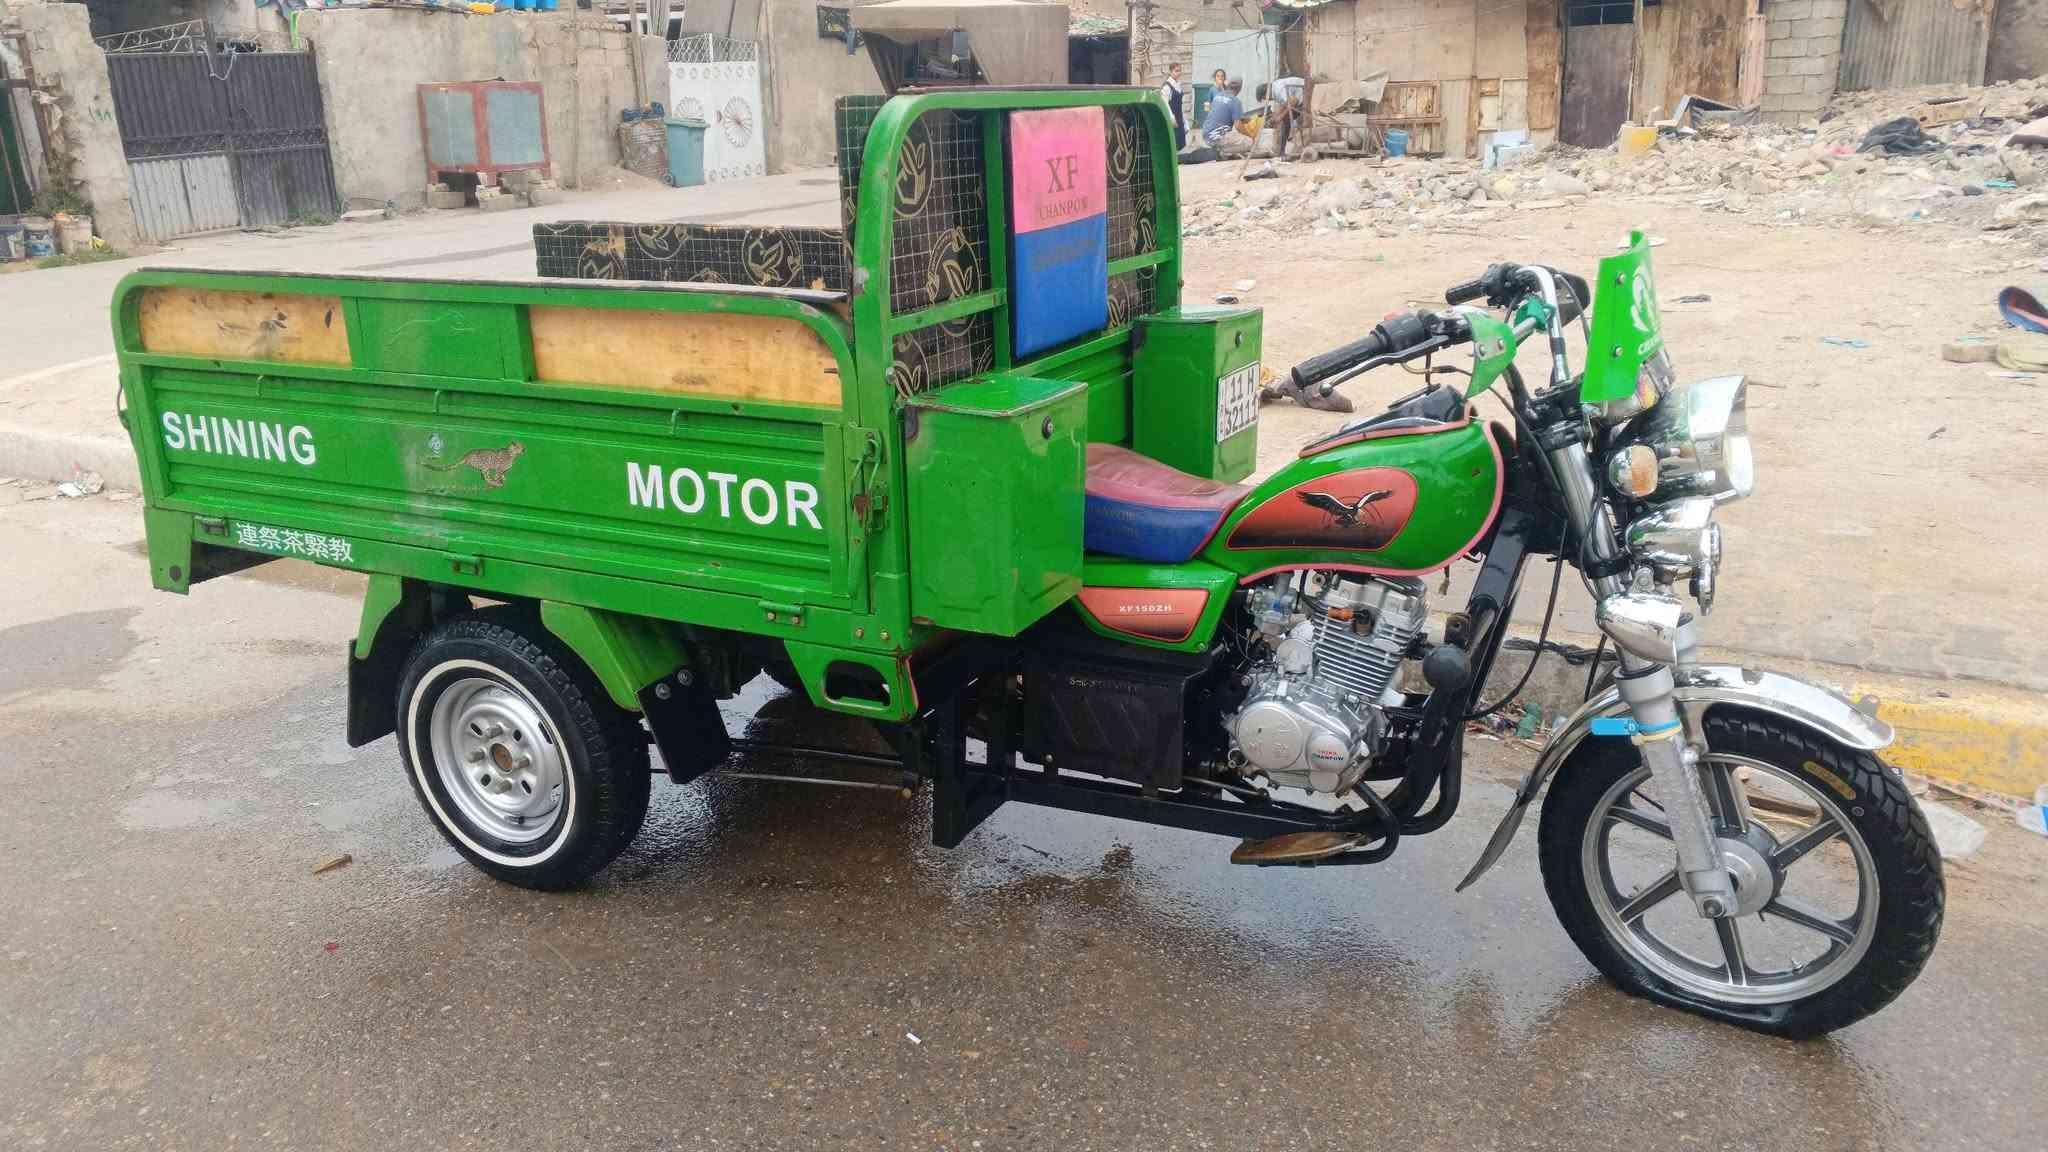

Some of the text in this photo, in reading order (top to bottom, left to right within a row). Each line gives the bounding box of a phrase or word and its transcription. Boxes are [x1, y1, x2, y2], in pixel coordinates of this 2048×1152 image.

[1046, 154, 1079, 194] XF
[1230, 367, 1255, 403] 11 H
[1225, 394, 1257, 435] 32111
[162, 411, 824, 530] SHINING MOTOR
